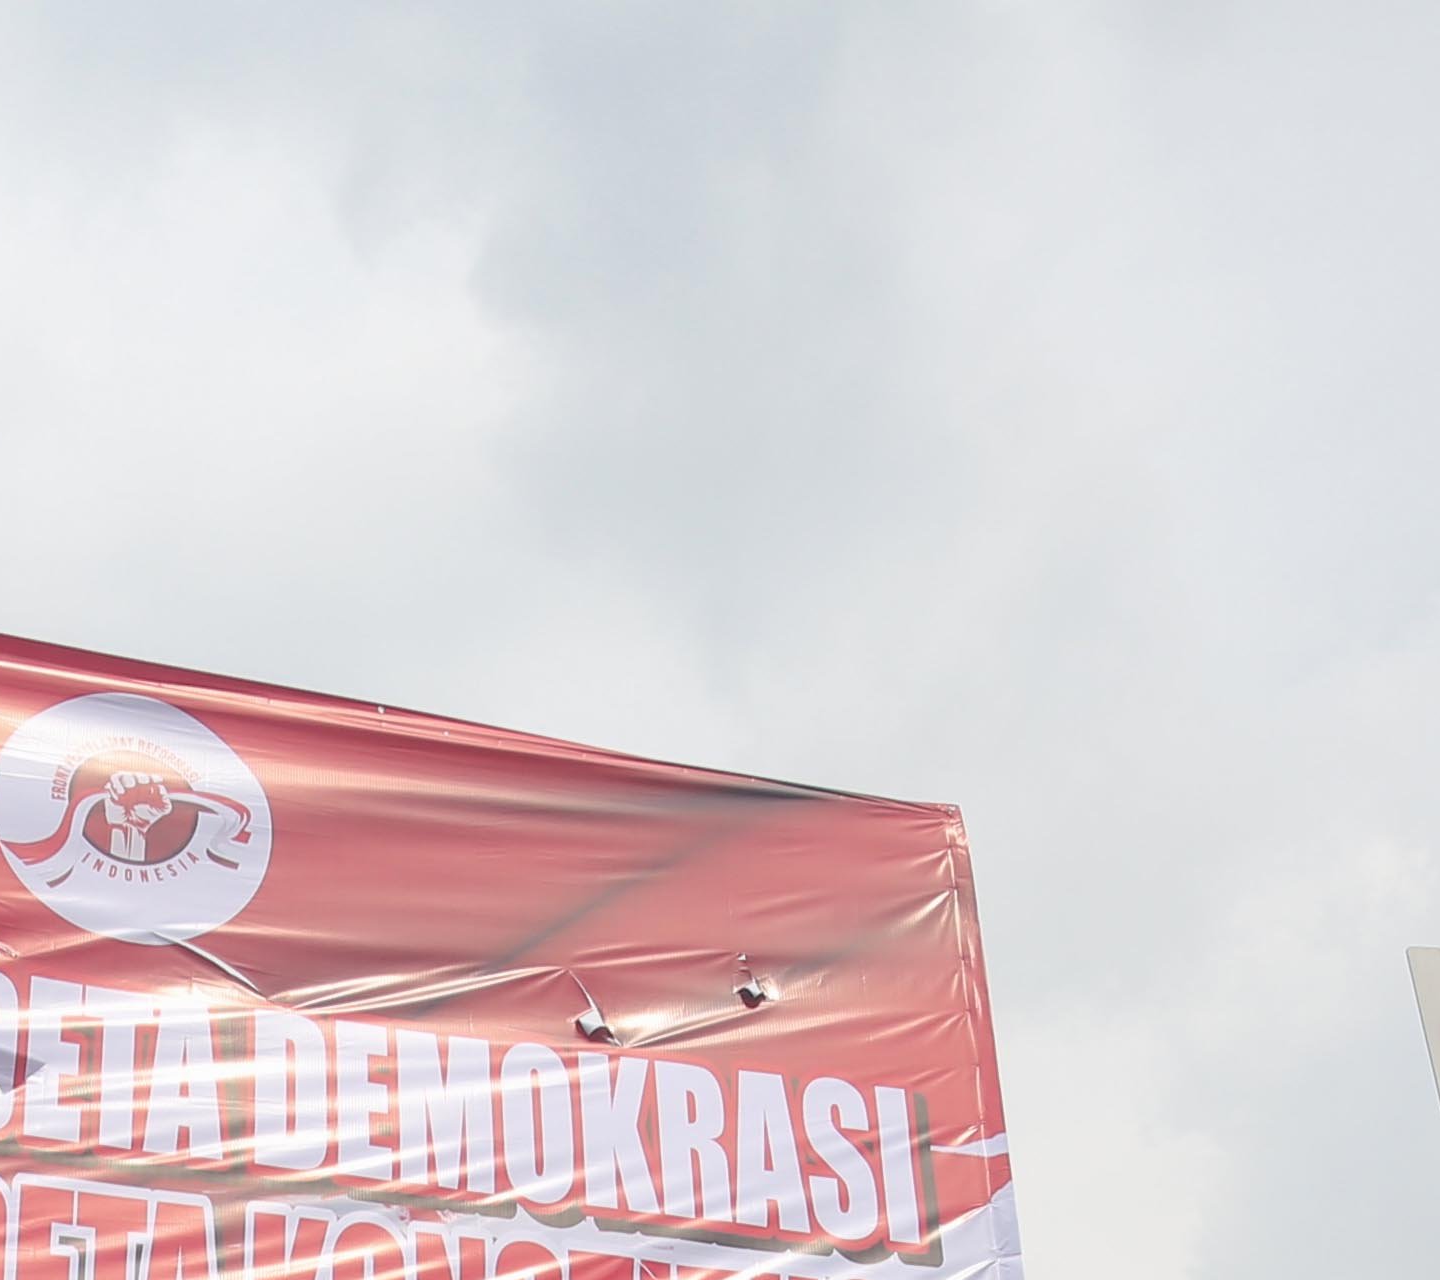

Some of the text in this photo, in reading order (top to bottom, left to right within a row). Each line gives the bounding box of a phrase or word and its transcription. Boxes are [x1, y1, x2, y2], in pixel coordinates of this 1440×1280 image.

[51, 765, 71, 800] FRONT
[81, 851, 200, 882] INDONESIA
[254, 1015, 934, 1255] DEMOKRASI
